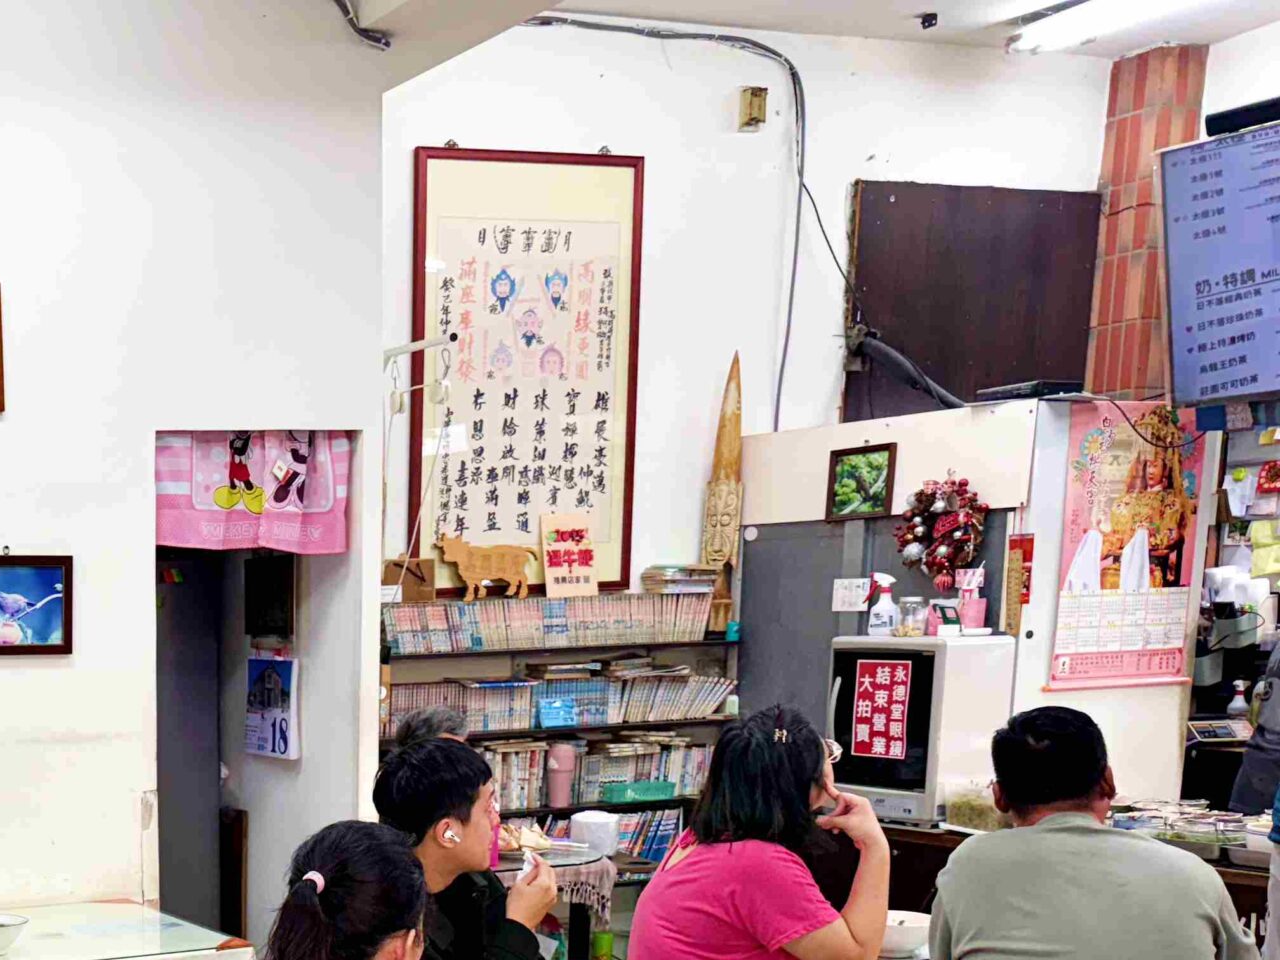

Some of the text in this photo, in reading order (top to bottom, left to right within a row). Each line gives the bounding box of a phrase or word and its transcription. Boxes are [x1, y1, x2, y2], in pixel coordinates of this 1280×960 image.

[270, 717, 288, 755] 18
[856, 674, 873, 743] 大拍賣
[871, 666, 891, 755] 結束營業
[889, 665, 907, 757] 永德堂眼鏡
